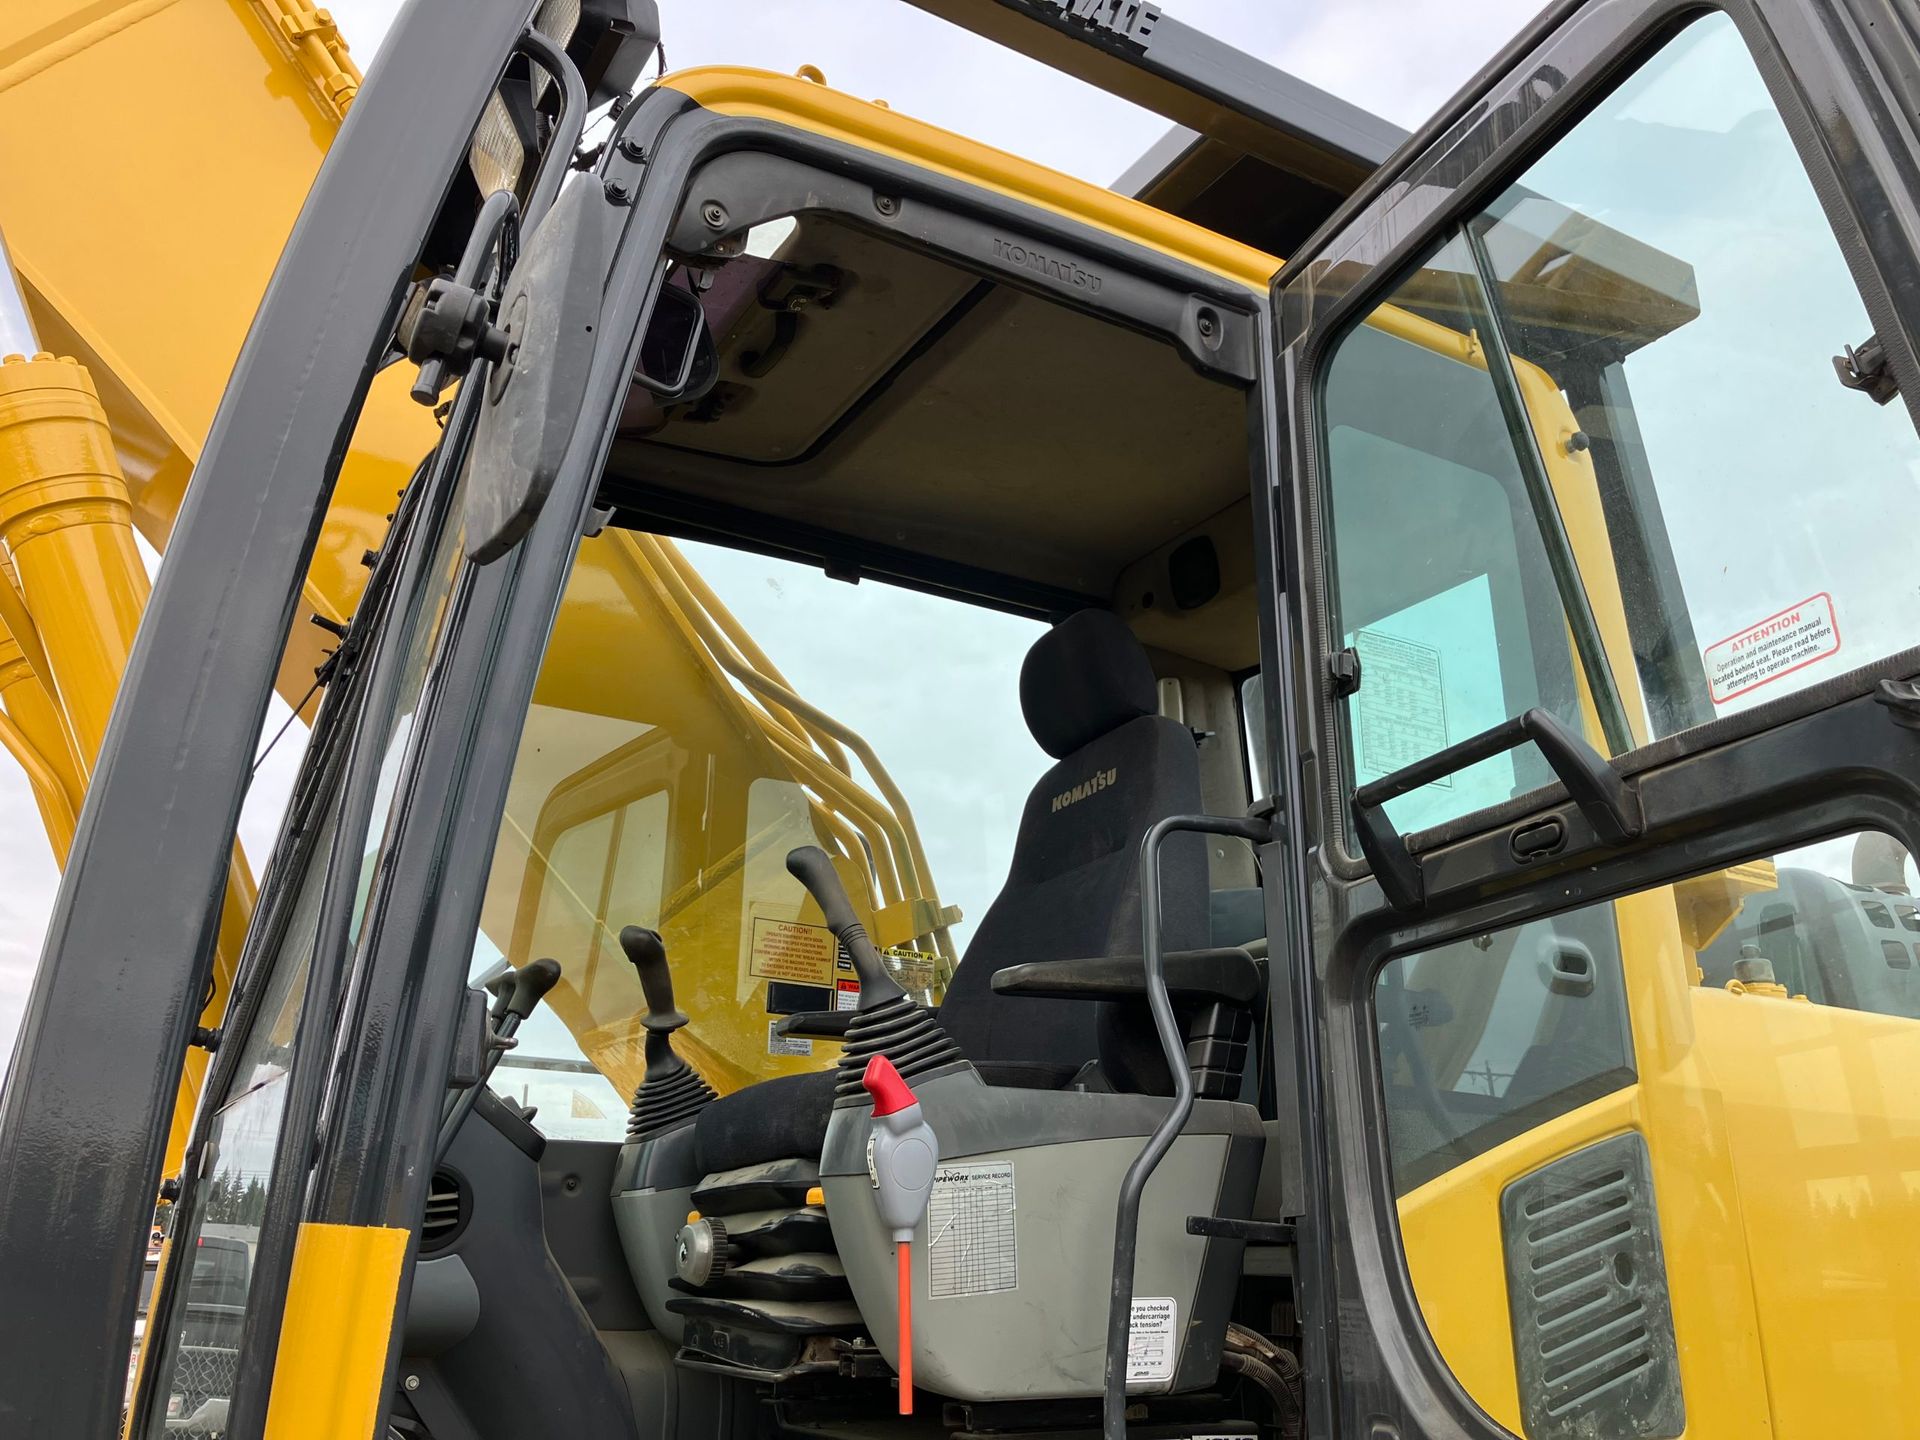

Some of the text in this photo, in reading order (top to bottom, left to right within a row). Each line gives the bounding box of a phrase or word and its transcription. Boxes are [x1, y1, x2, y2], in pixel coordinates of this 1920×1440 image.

[992, 238, 1102, 295] KOMATSU
[1717, 617, 1822, 672] Operation and maintenance manual
[1731, 612, 1801, 653] ATTENTION
[1713, 670, 1734, 686] located
[1735, 662, 1755, 677] behind
[1771, 646, 1793, 659] Please
[1794, 636, 1809, 649] read
[1810, 626, 1831, 641] before
[1726, 671, 1758, 690] attempting
[1766, 656, 1790, 672] operate
[1791, 643, 1821, 661] machine.
[1052, 767, 1117, 813] KOMATSU
[893, 950, 924, 959] CAUTION
[934, 1174, 969, 1183] IPEWORX
[972, 1173, 991, 1181] SERVICE
[1133, 1313, 1170, 1321] undercarriage
[1147, 1304, 1170, 1312] checked
[1140, 1320, 1163, 1328] tension?
